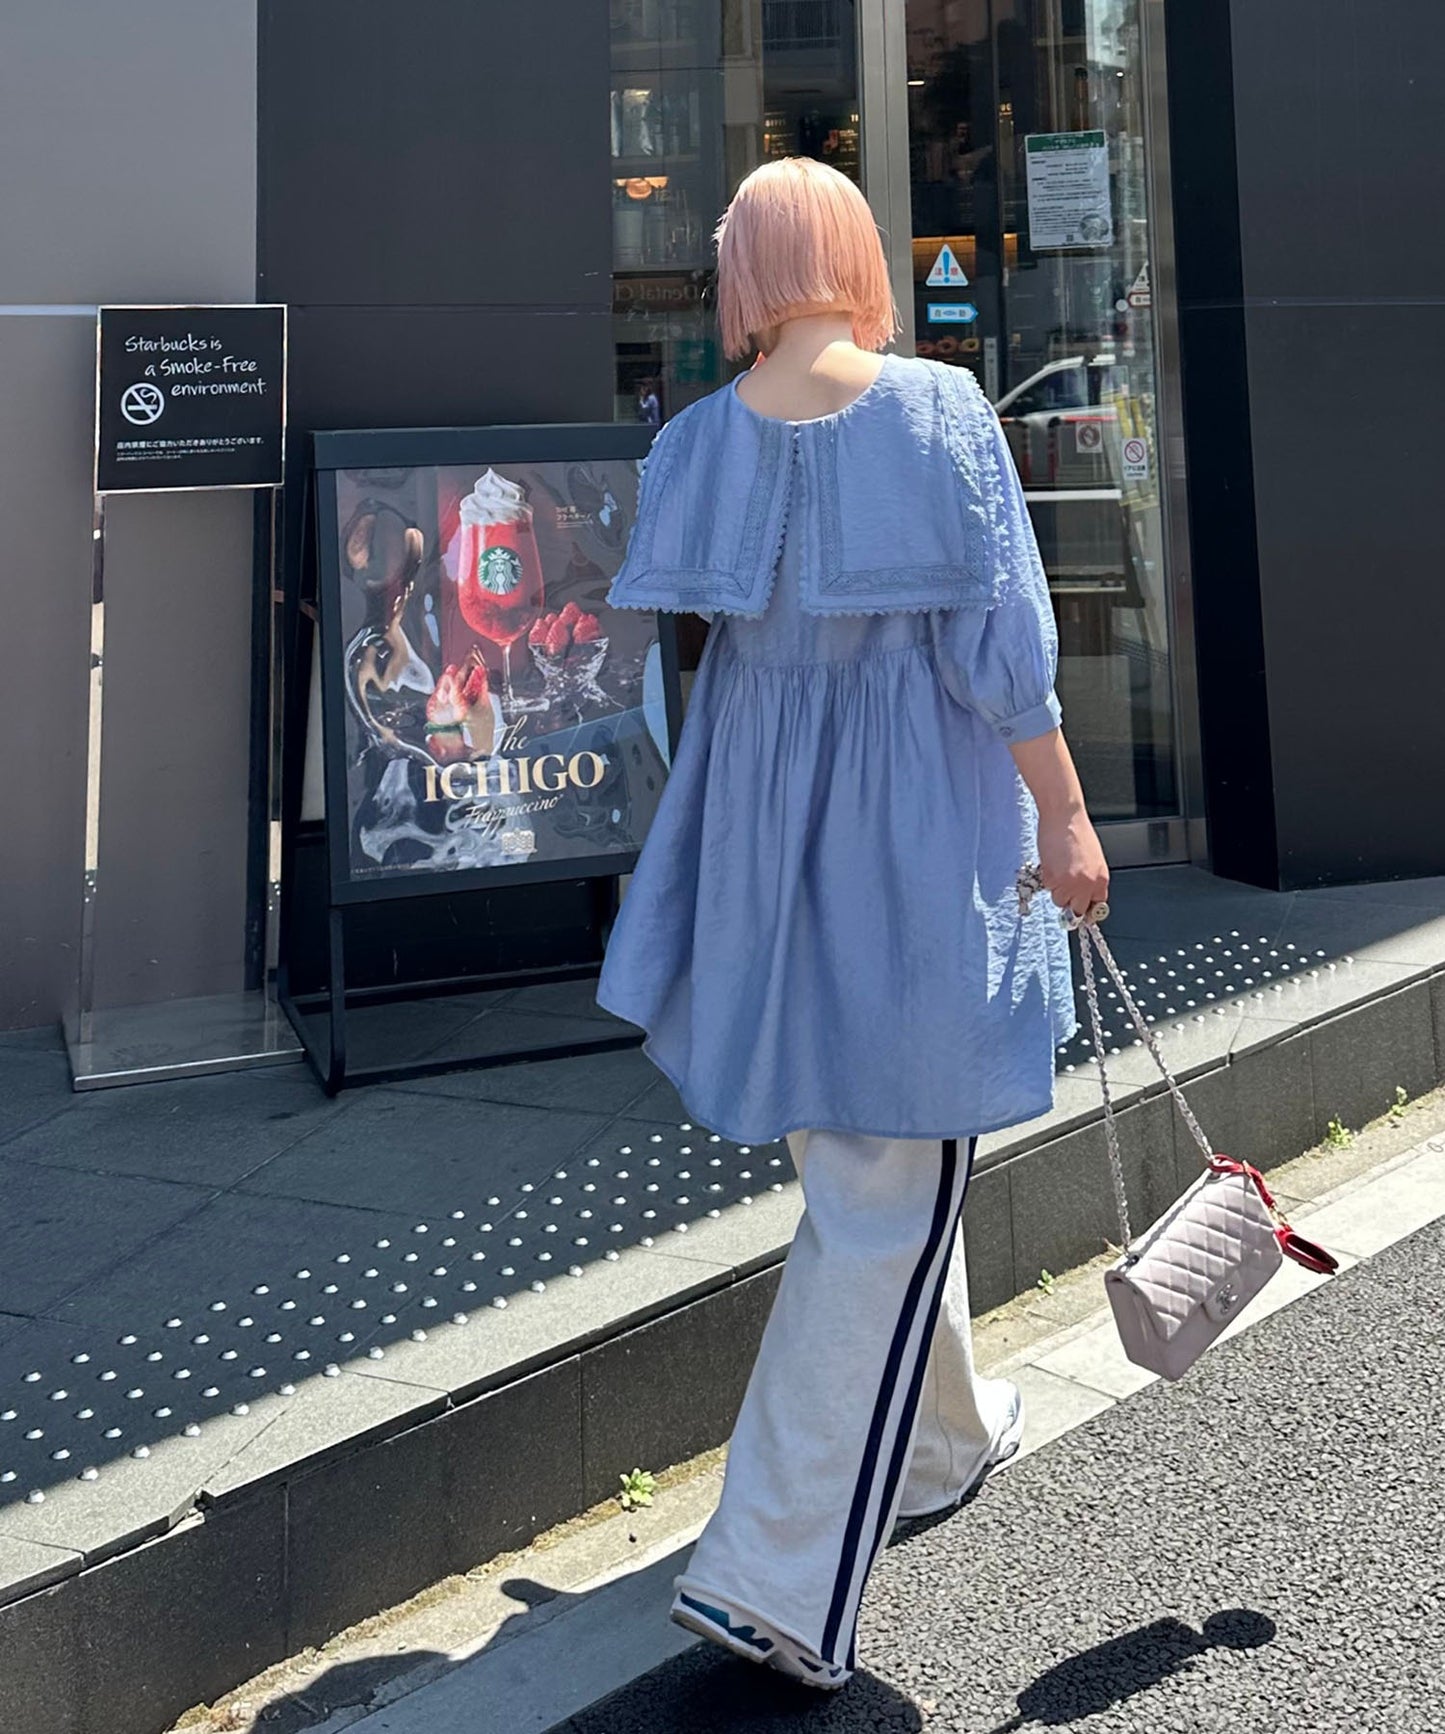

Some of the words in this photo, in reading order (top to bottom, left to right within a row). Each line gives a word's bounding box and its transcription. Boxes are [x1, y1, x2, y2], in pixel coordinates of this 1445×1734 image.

[124, 333, 207, 352] Starbucks
[209, 336, 223, 351] is
[144, 364, 156, 377] a
[490, 714, 529, 757] The
[422, 750, 606, 803] ICHIGO
